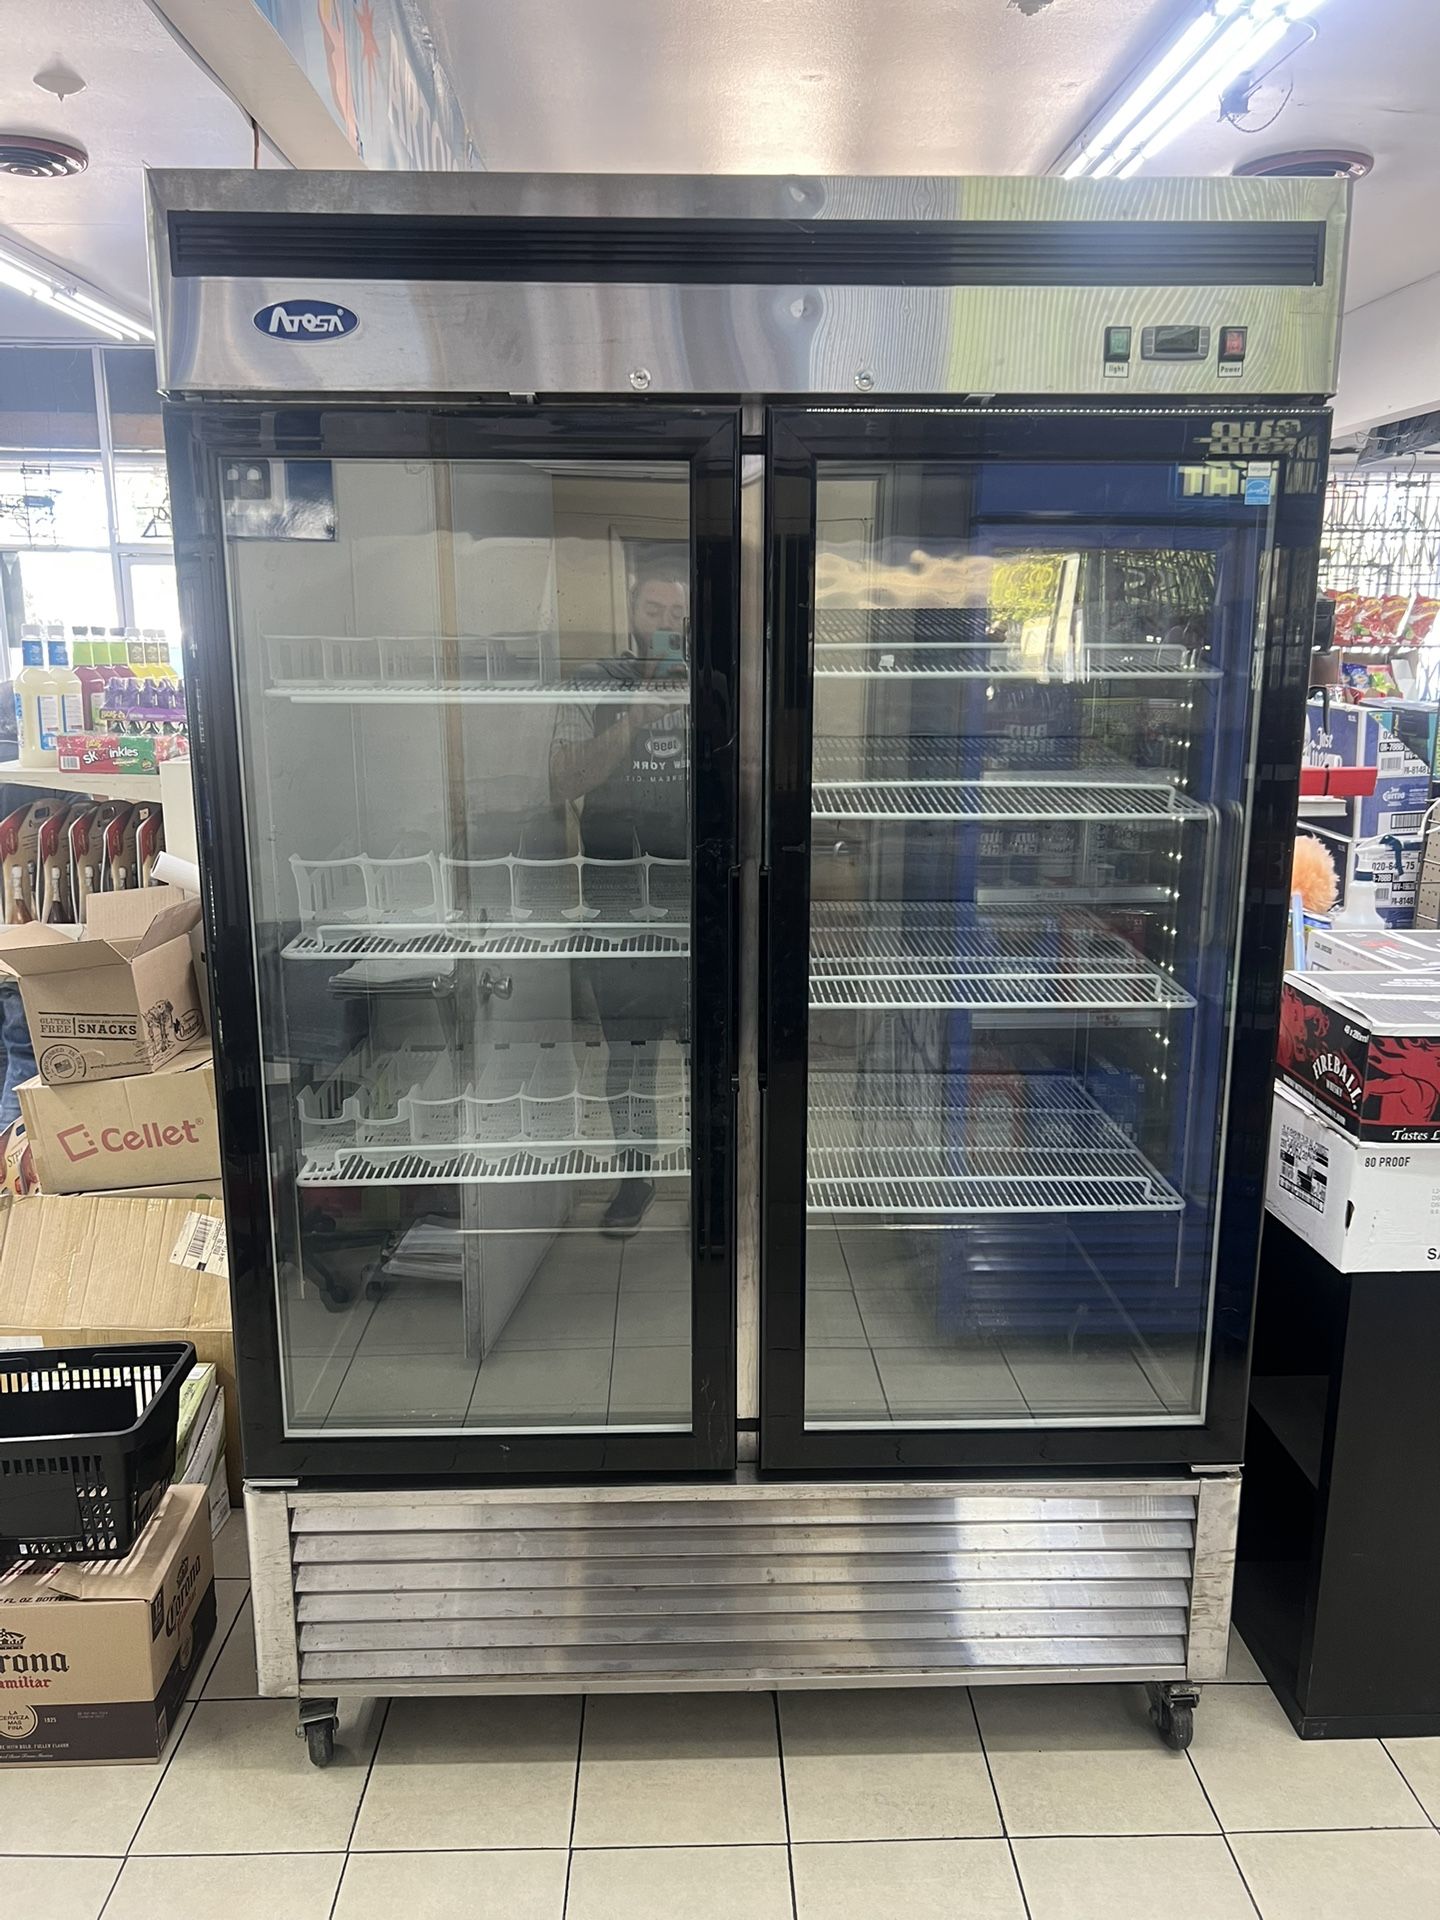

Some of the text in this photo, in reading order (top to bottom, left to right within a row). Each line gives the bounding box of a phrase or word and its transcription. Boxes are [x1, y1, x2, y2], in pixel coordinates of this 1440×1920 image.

[40, 1018, 71, 1026] GLUTEN
[41, 1025, 72, 1034] FREE
[78, 1023, 137, 1036] SNACKS
[1312, 1053, 1362, 1104] FIREBALL
[101, 1120, 199, 1152] Cellet
[1391, 1128, 1428, 1141] Tastes
[1364, 1156, 1411, 1168] 80 PROOF
[0, 1652, 70, 1674] rona
[0, 1675, 52, 1689] amiliar
